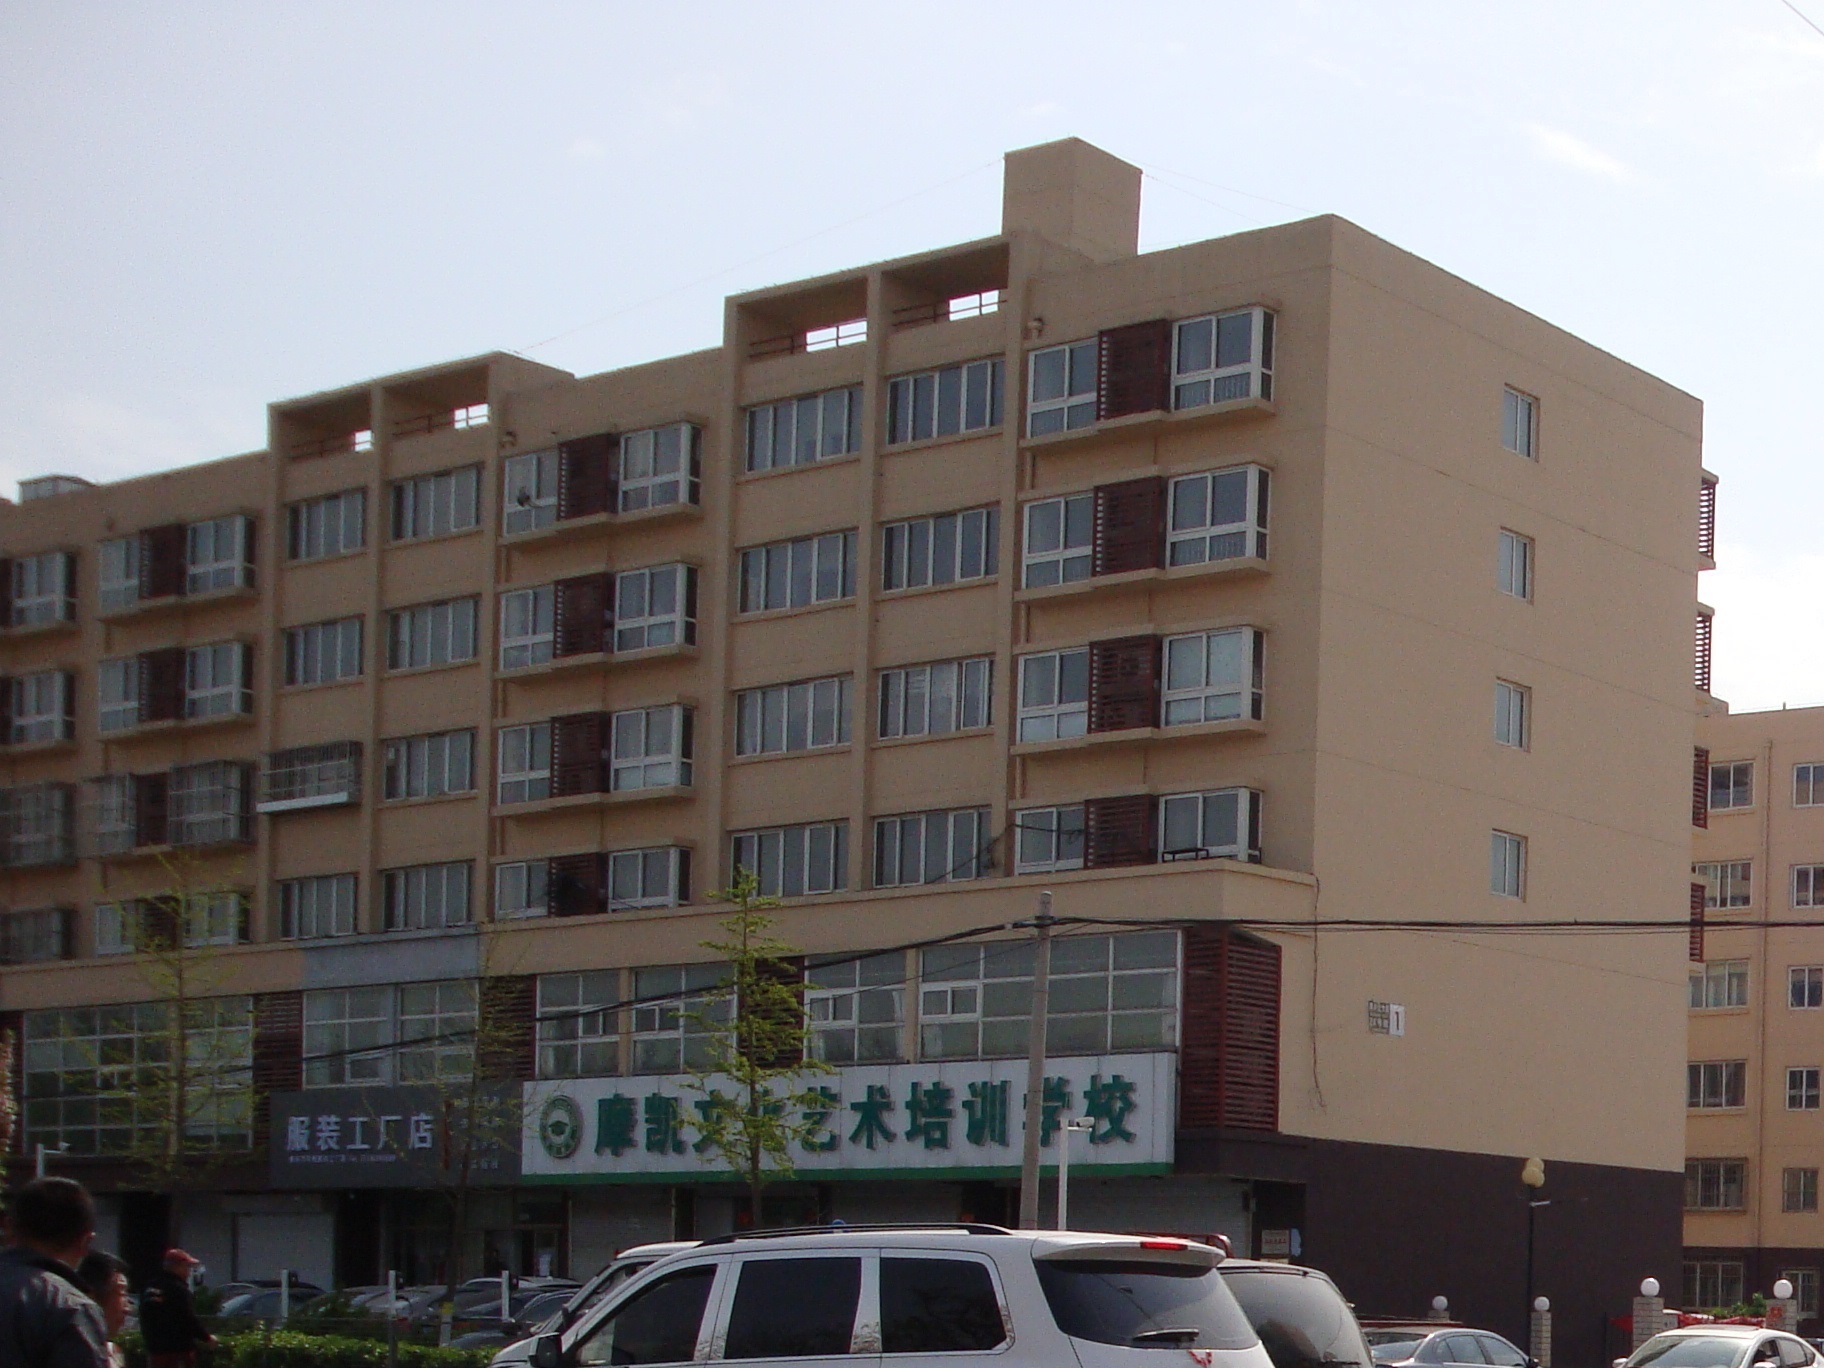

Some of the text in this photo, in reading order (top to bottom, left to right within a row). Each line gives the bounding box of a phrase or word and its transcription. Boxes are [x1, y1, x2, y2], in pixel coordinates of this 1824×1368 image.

[286, 1112, 435, 1152] 服装工厂店
